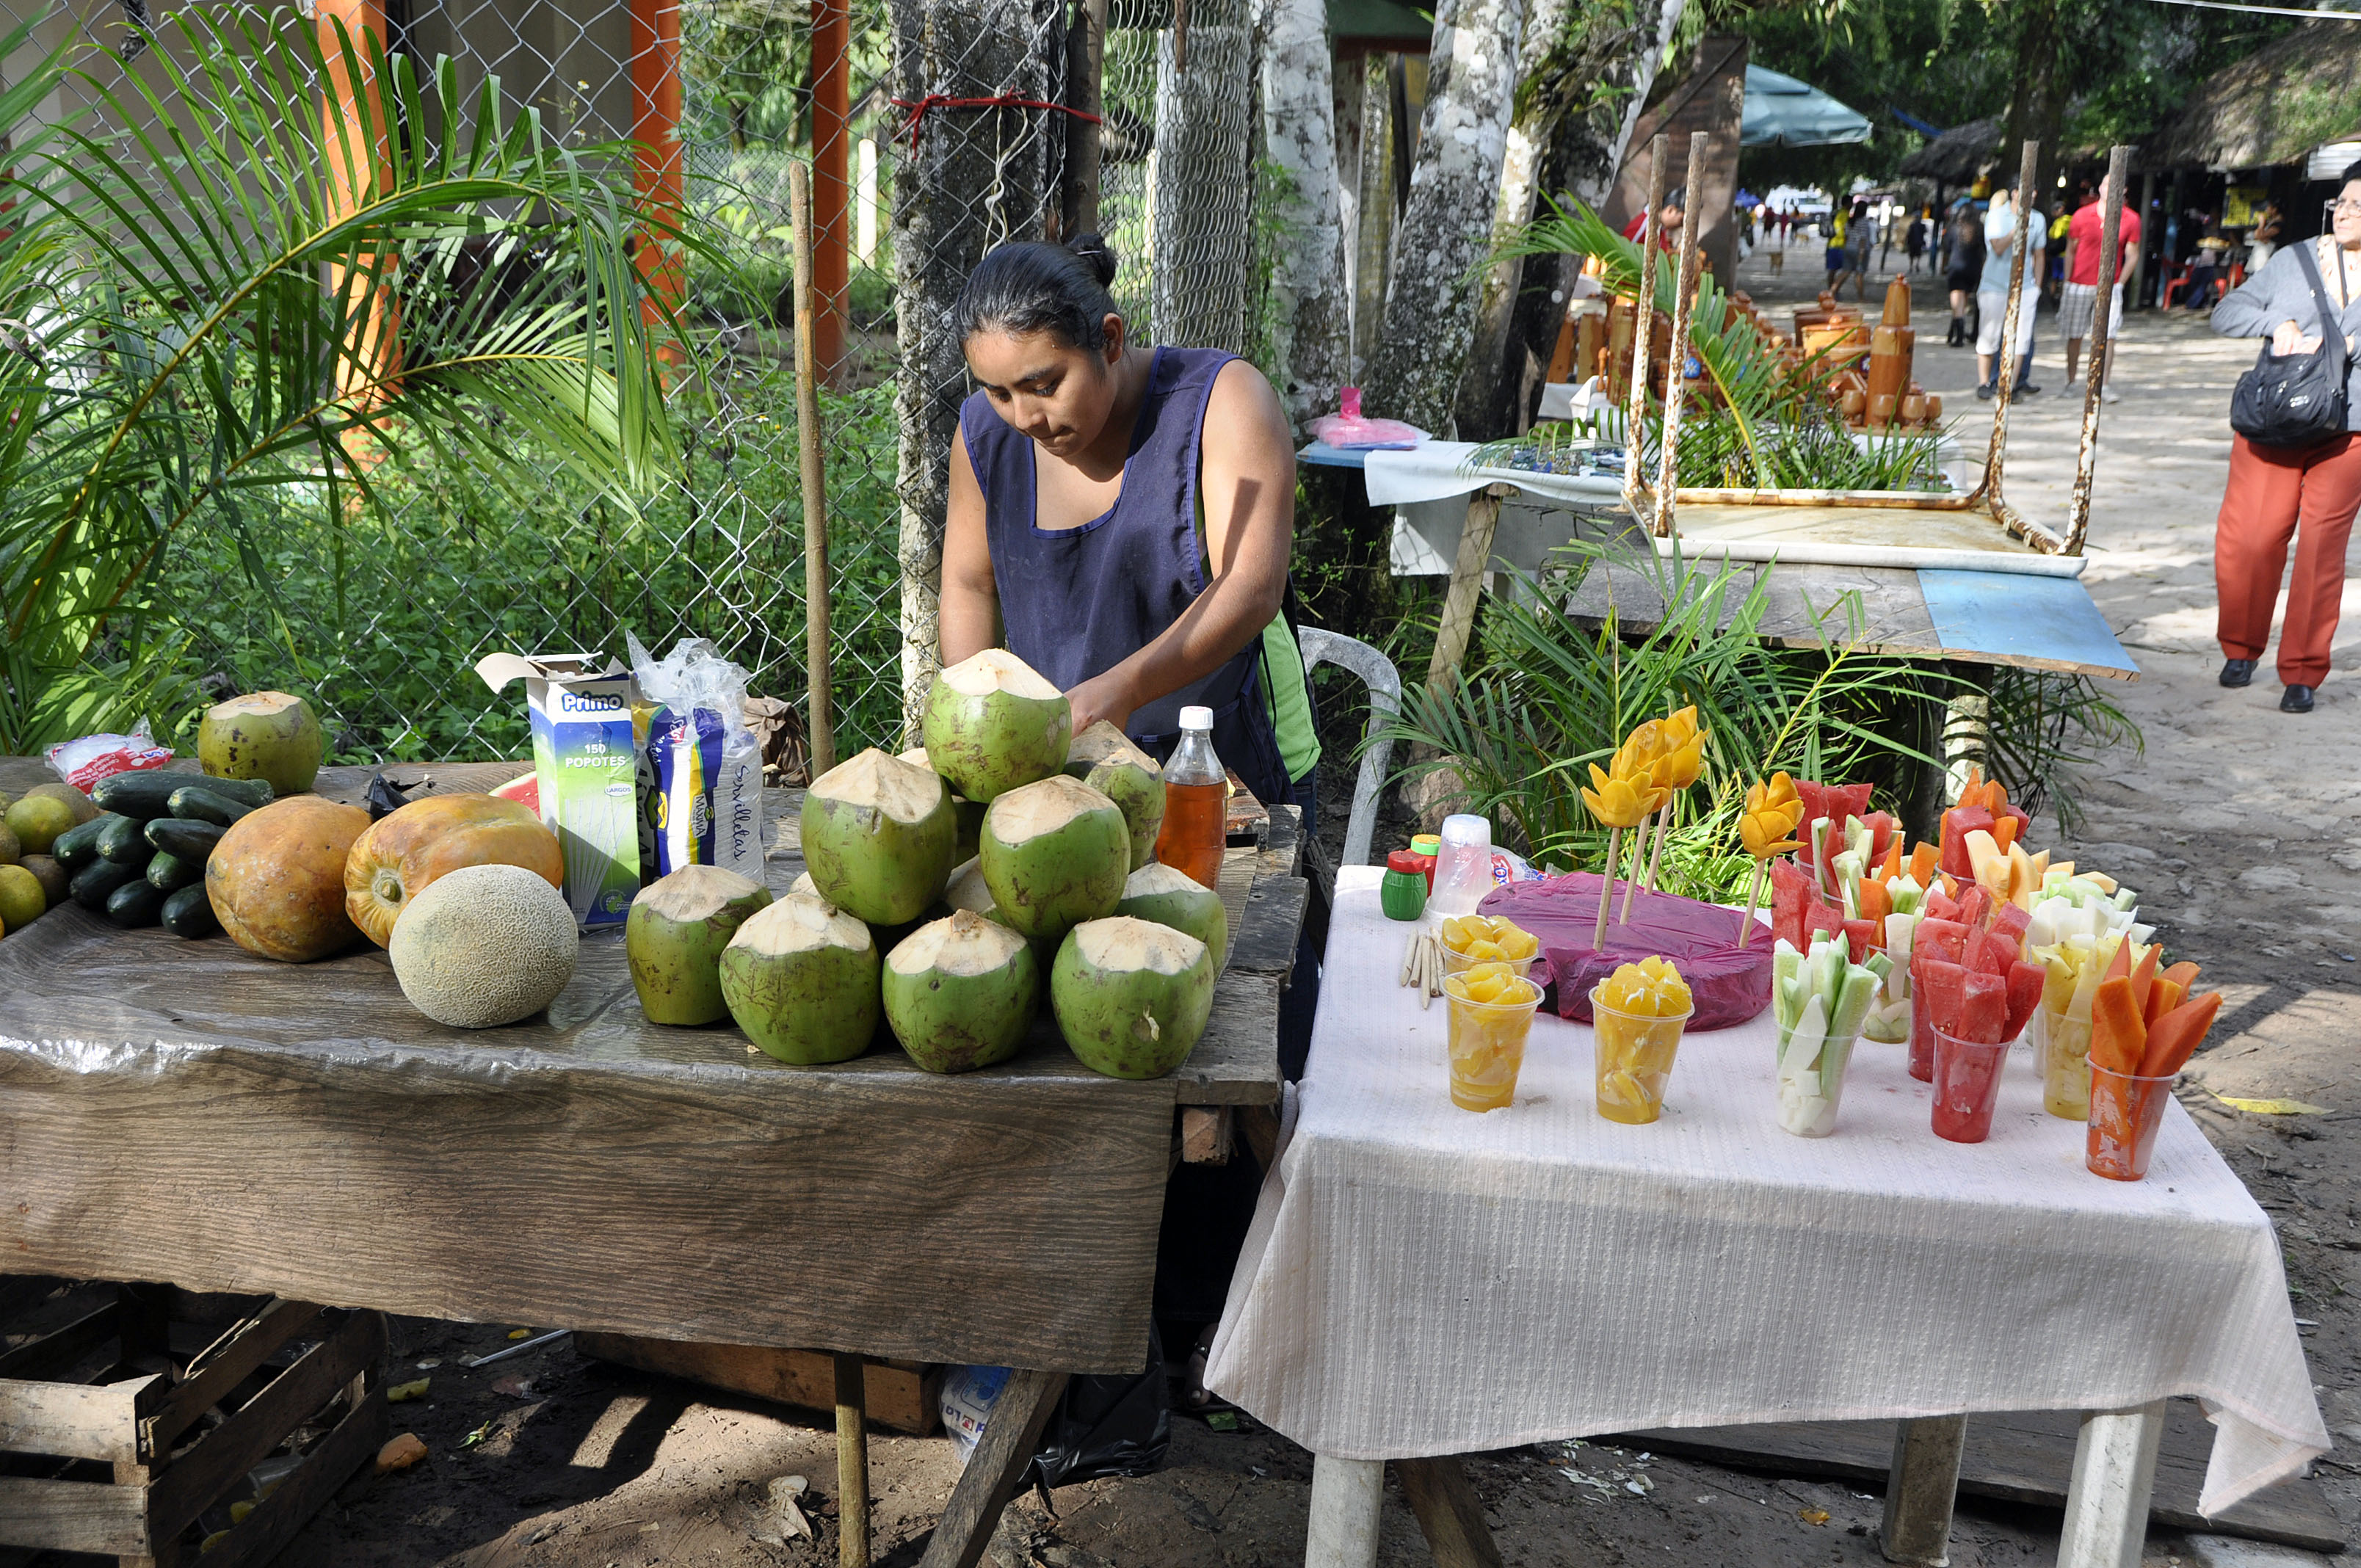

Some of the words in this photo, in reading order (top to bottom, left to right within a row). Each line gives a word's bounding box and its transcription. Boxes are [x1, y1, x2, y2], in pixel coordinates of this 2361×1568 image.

[562, 691, 622, 711] Primo
[584, 744, 606, 755] 150
[565, 756, 626, 768] POPOTES
[732, 765, 752, 861] Servilletas
